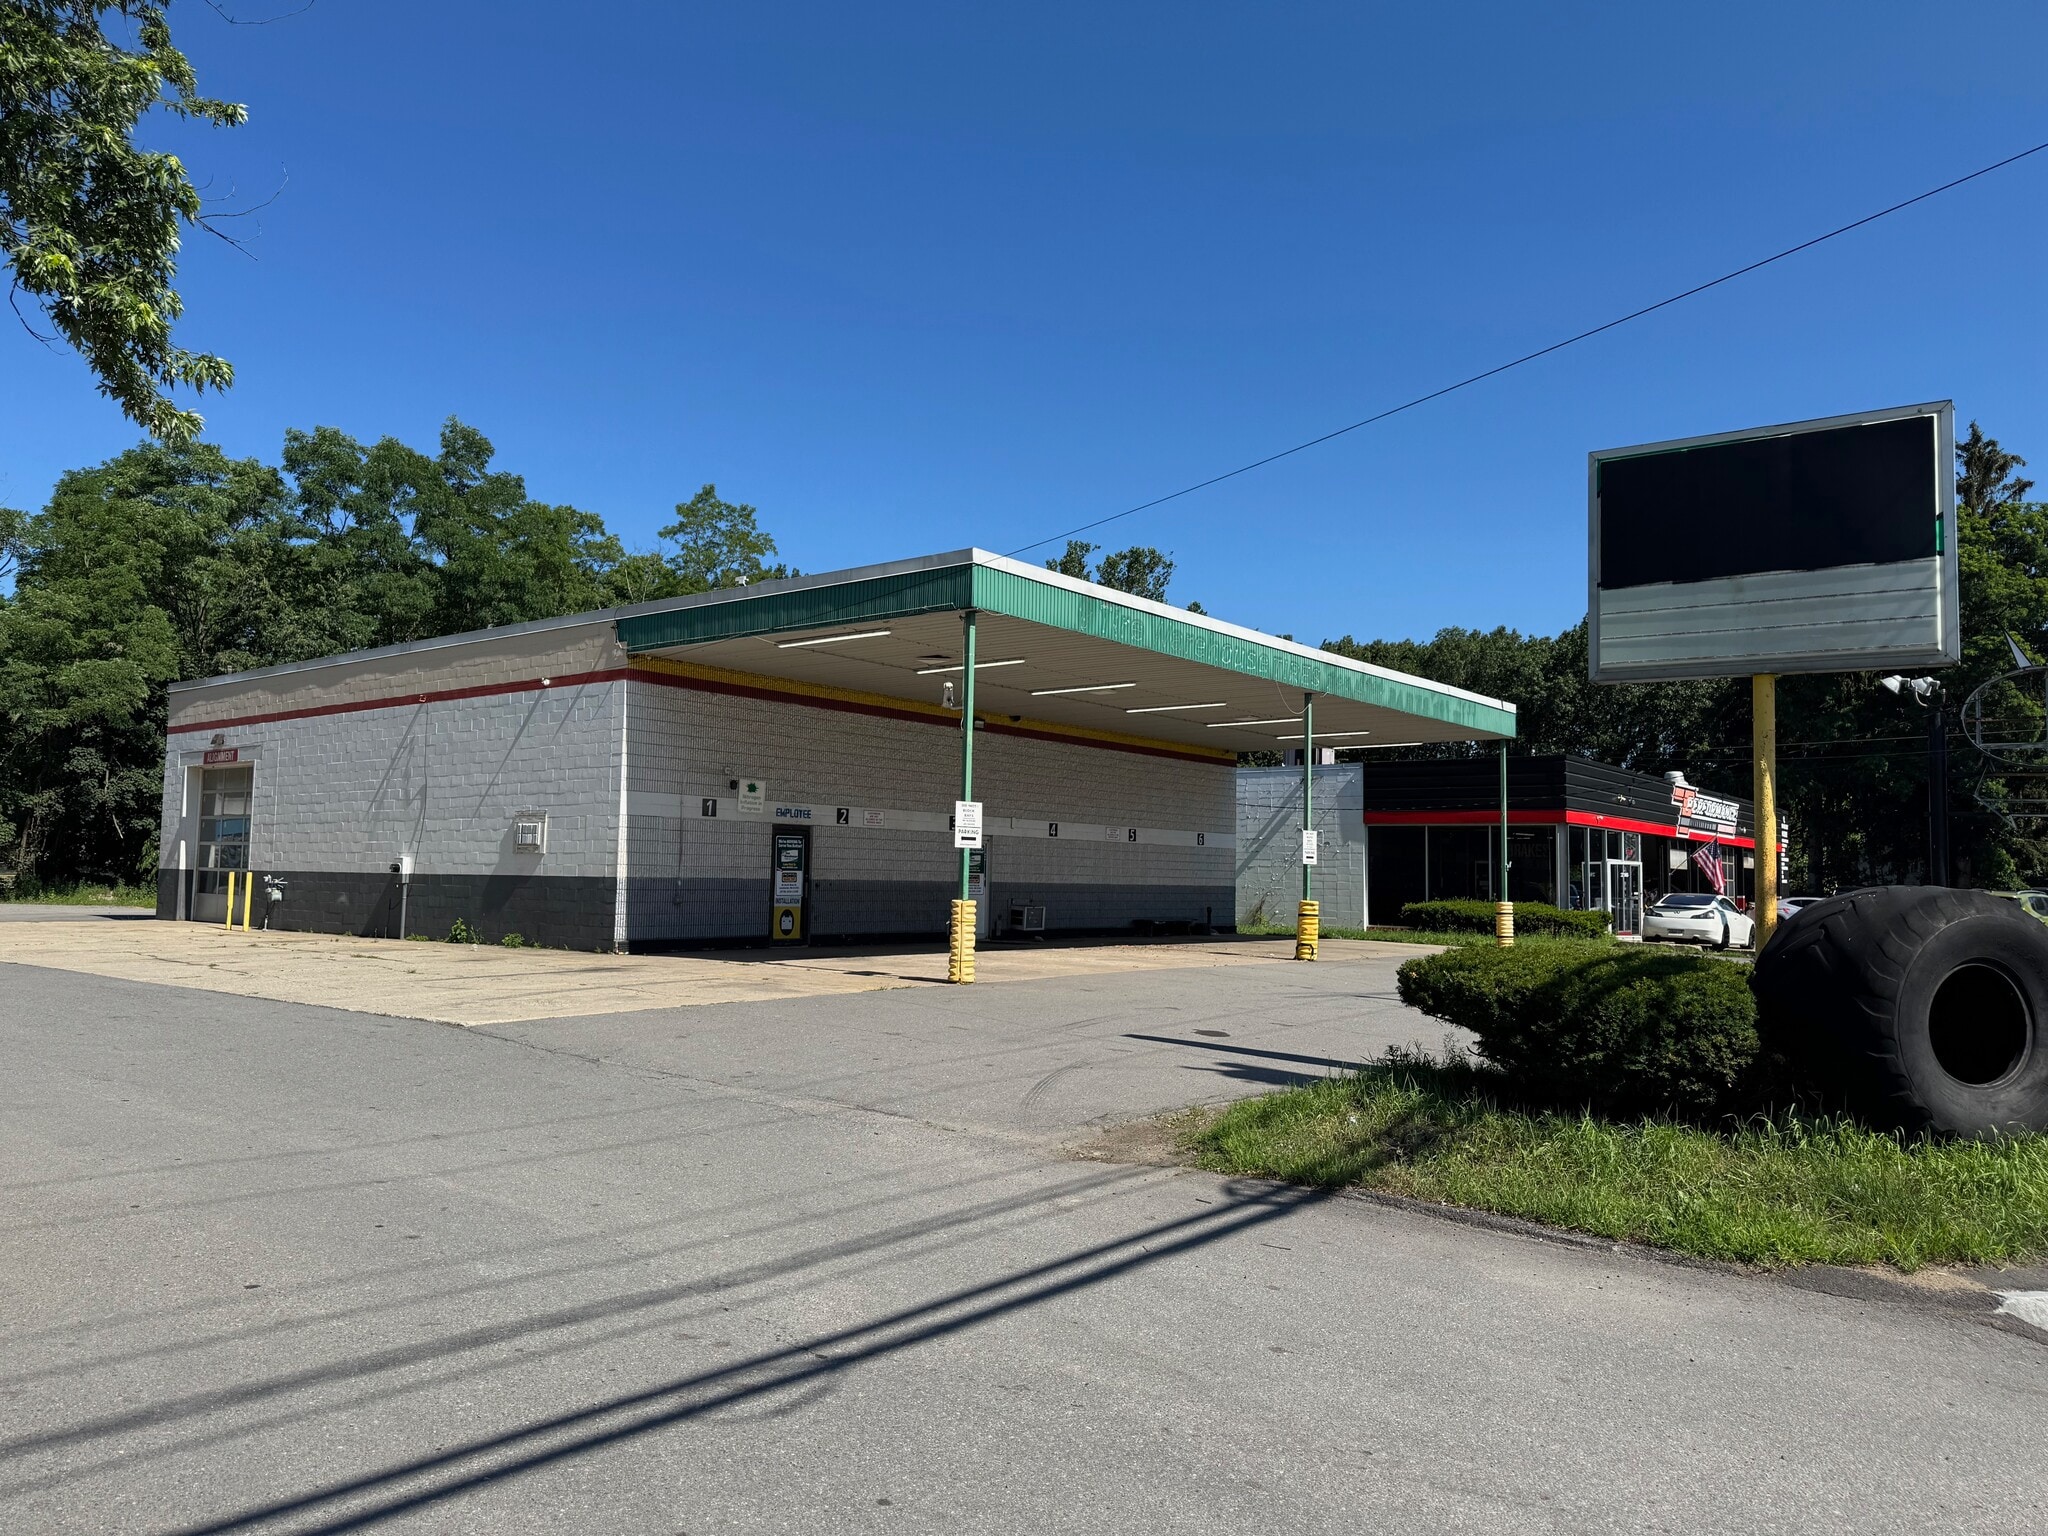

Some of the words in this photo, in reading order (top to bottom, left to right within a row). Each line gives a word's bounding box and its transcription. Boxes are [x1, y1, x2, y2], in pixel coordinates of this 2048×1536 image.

[207, 750, 235, 763] ALIGNMENT
[706, 800, 713, 816] 1
[776, 808, 811, 819] EMPLOYEE
[840, 809, 848, 824] 2
[1129, 829, 1135, 841] 5
